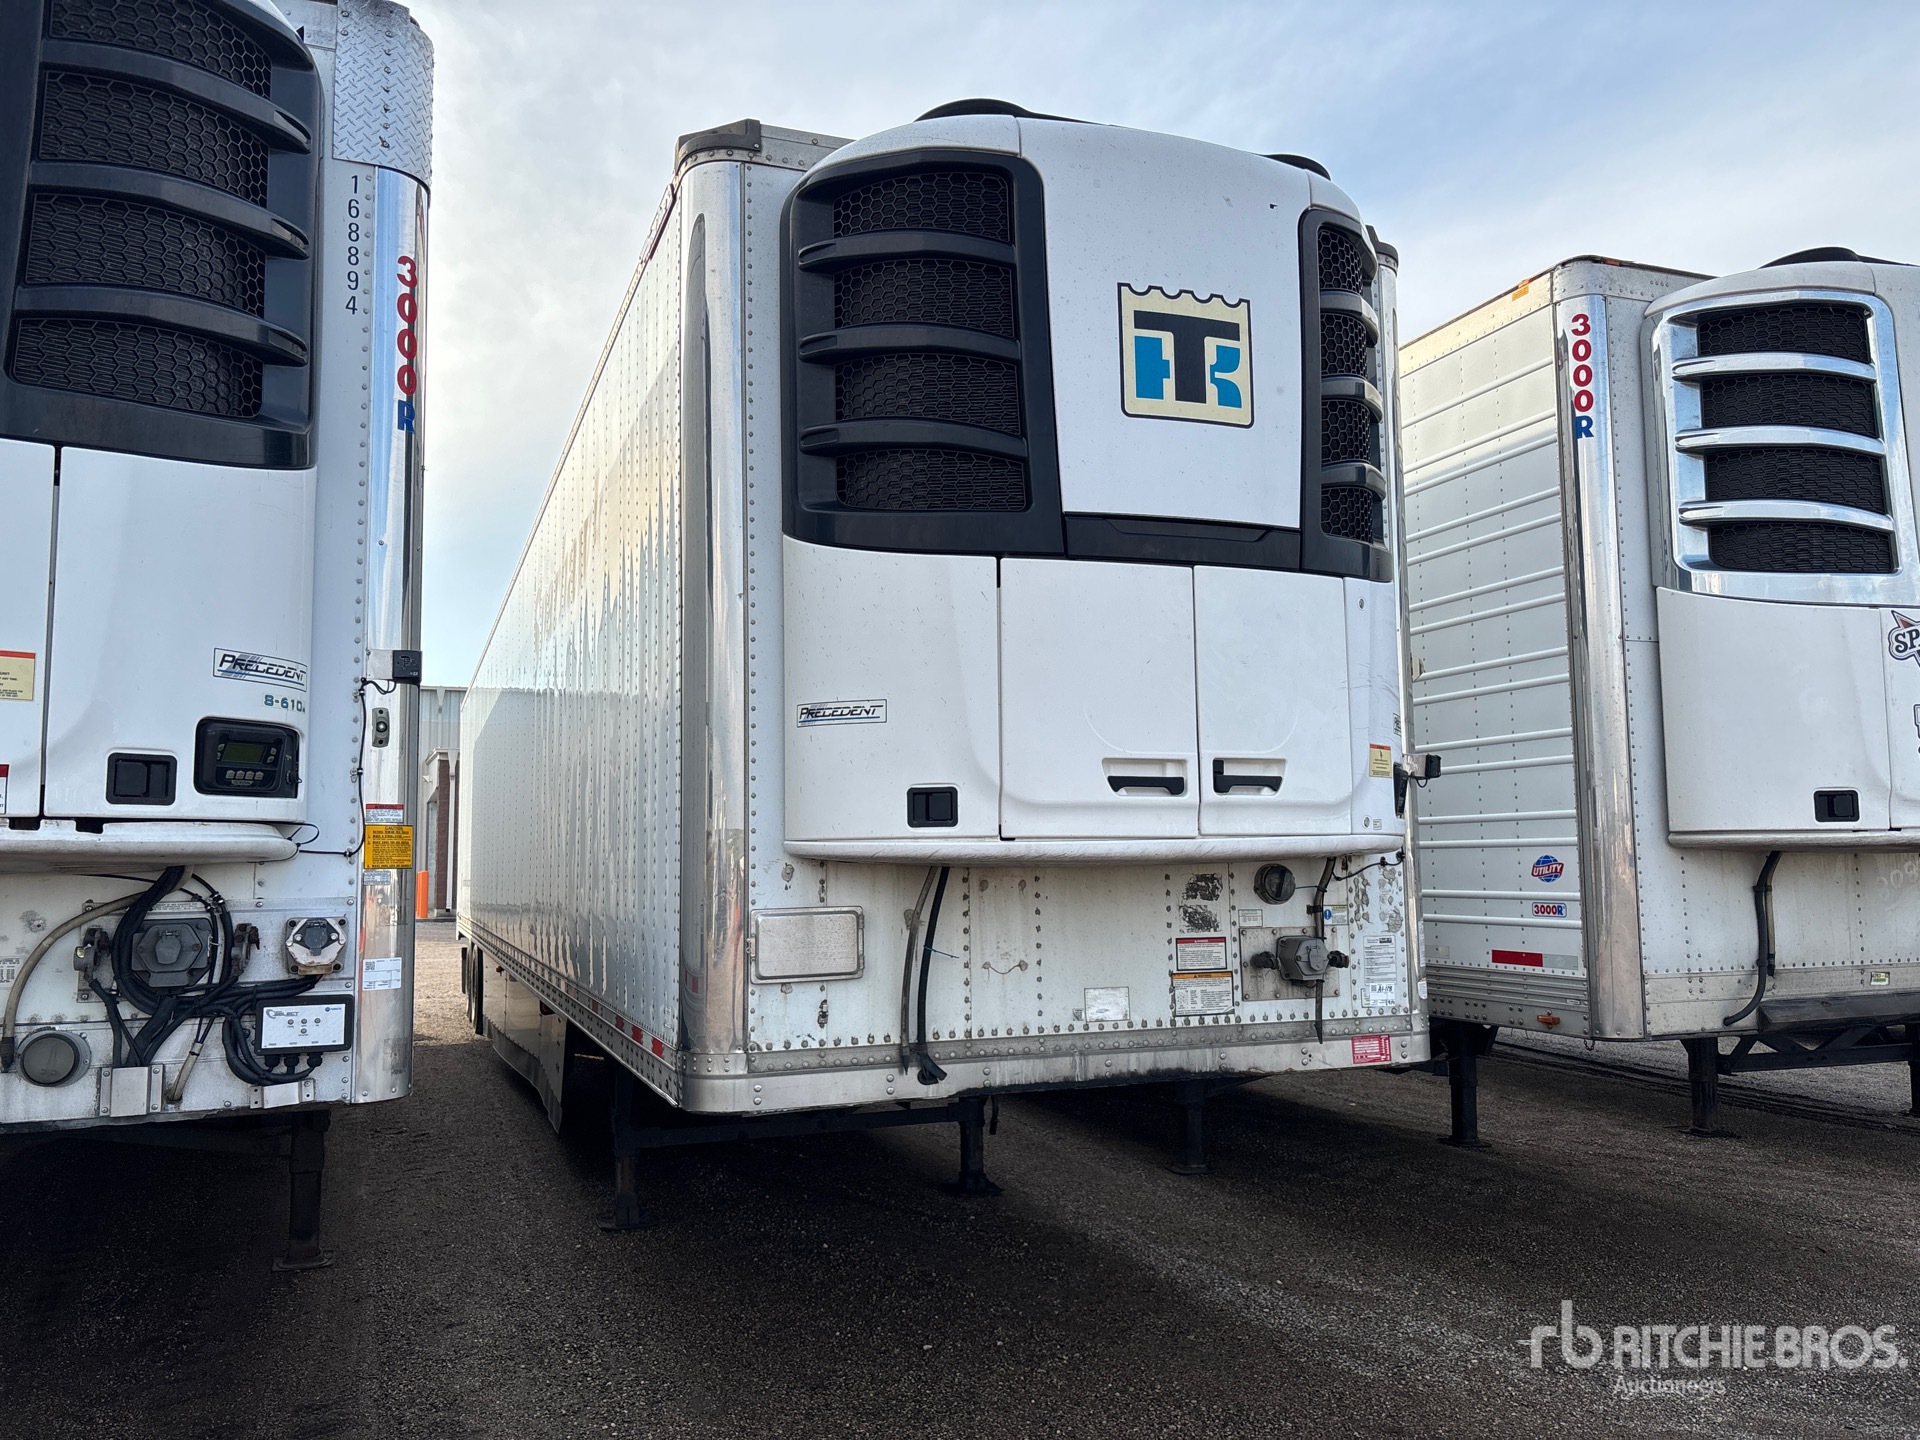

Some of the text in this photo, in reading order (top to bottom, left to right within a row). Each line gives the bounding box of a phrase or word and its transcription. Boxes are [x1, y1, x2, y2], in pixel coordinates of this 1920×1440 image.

[345, 174, 359, 315] 168894
[397, 255, 418, 433] 3000R
[1571, 313, 1594, 439] 3000R
[218, 653, 307, 682] PRECEDENT
[799, 704, 884, 720] PRECEDENT
[1532, 864, 1562, 876] UTILITY
[1534, 904, 1564, 916] 3000R
